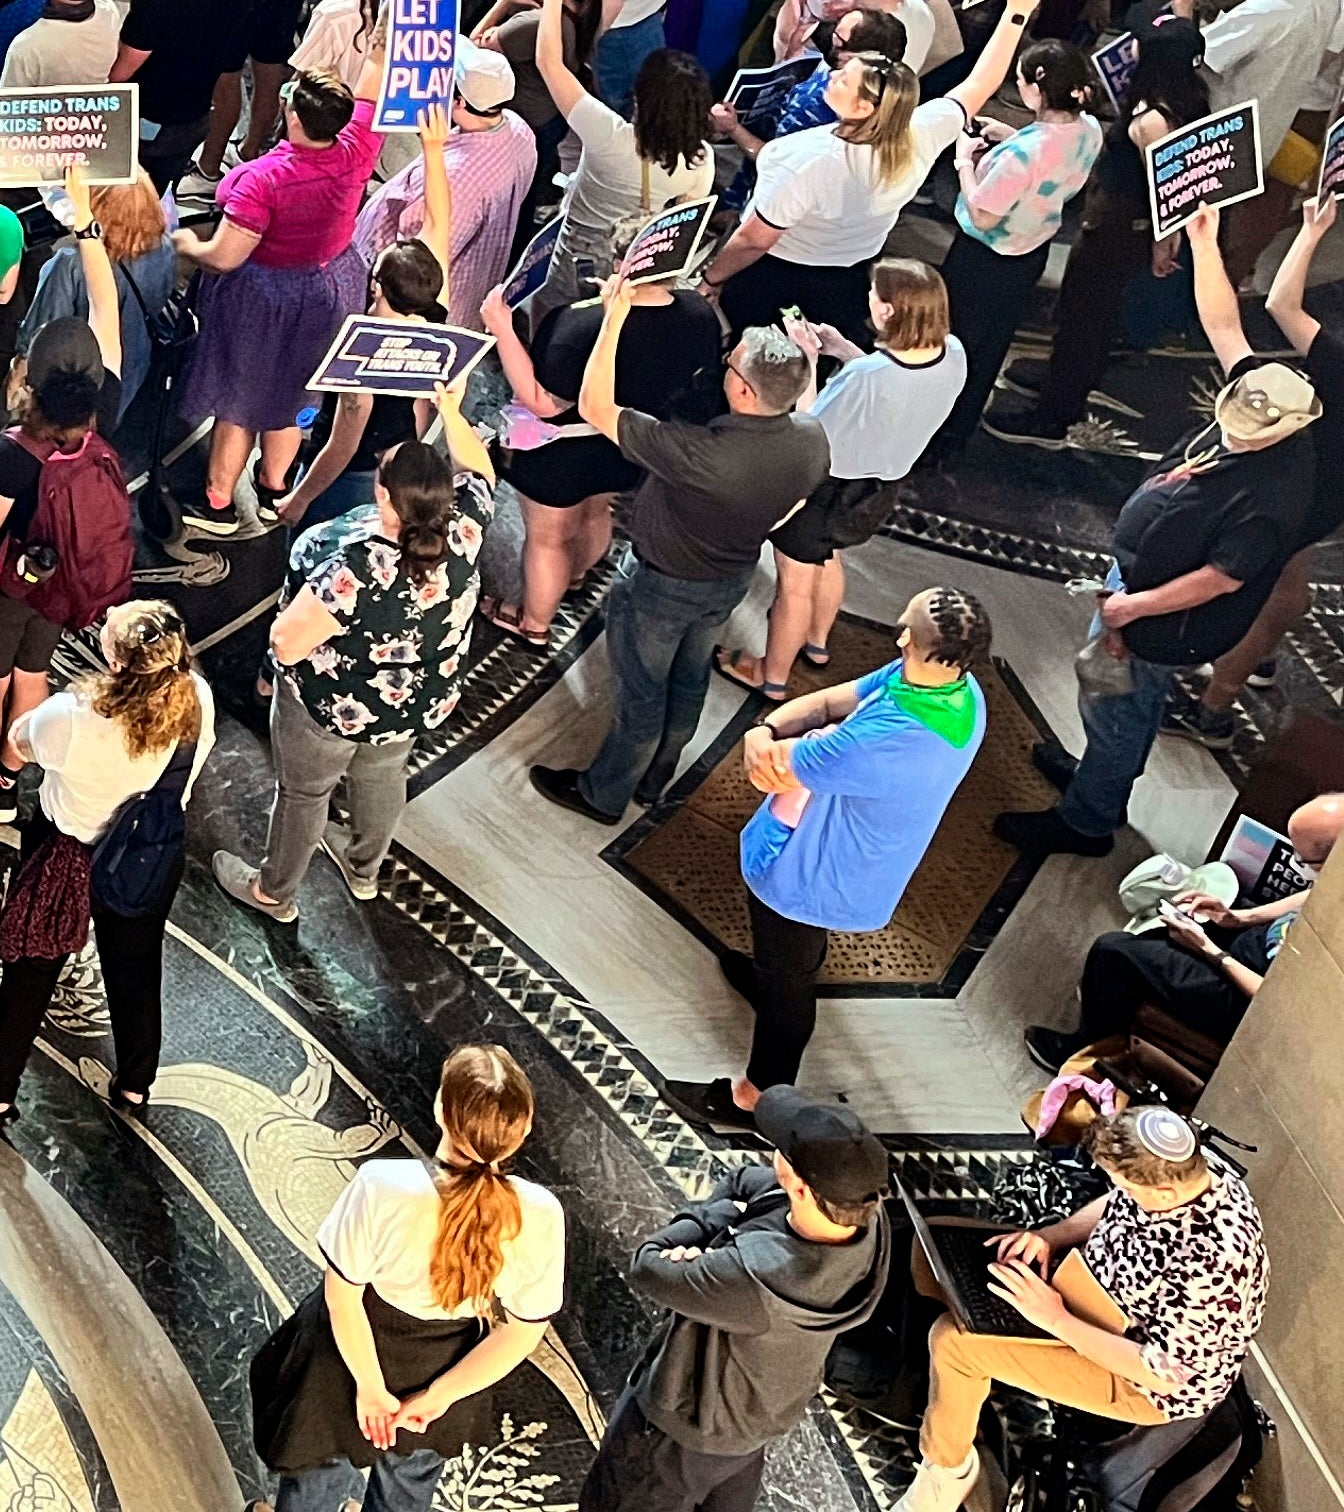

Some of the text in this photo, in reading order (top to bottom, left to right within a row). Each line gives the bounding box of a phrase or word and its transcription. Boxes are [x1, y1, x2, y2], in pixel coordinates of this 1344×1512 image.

[392, 29, 452, 62] KIDS
[387, 67, 454, 99] PLAY
[0, 96, 120, 116] DEFEND TRANS
[0, 115, 108, 133] KIDS: TODAY,
[0, 134, 108, 151] TOMORROW,
[1155, 116, 1244, 166] DEFEND TRANS
[14, 152, 90, 169] FOREVER.
[1156, 138, 1234, 182] KIDS: TODAY,
[1158, 154, 1235, 198] TOMORROW,
[1160, 176, 1224, 217] & FOREVER.
[656, 208, 698, 229] TRANS
[382, 336, 412, 348] STOP
